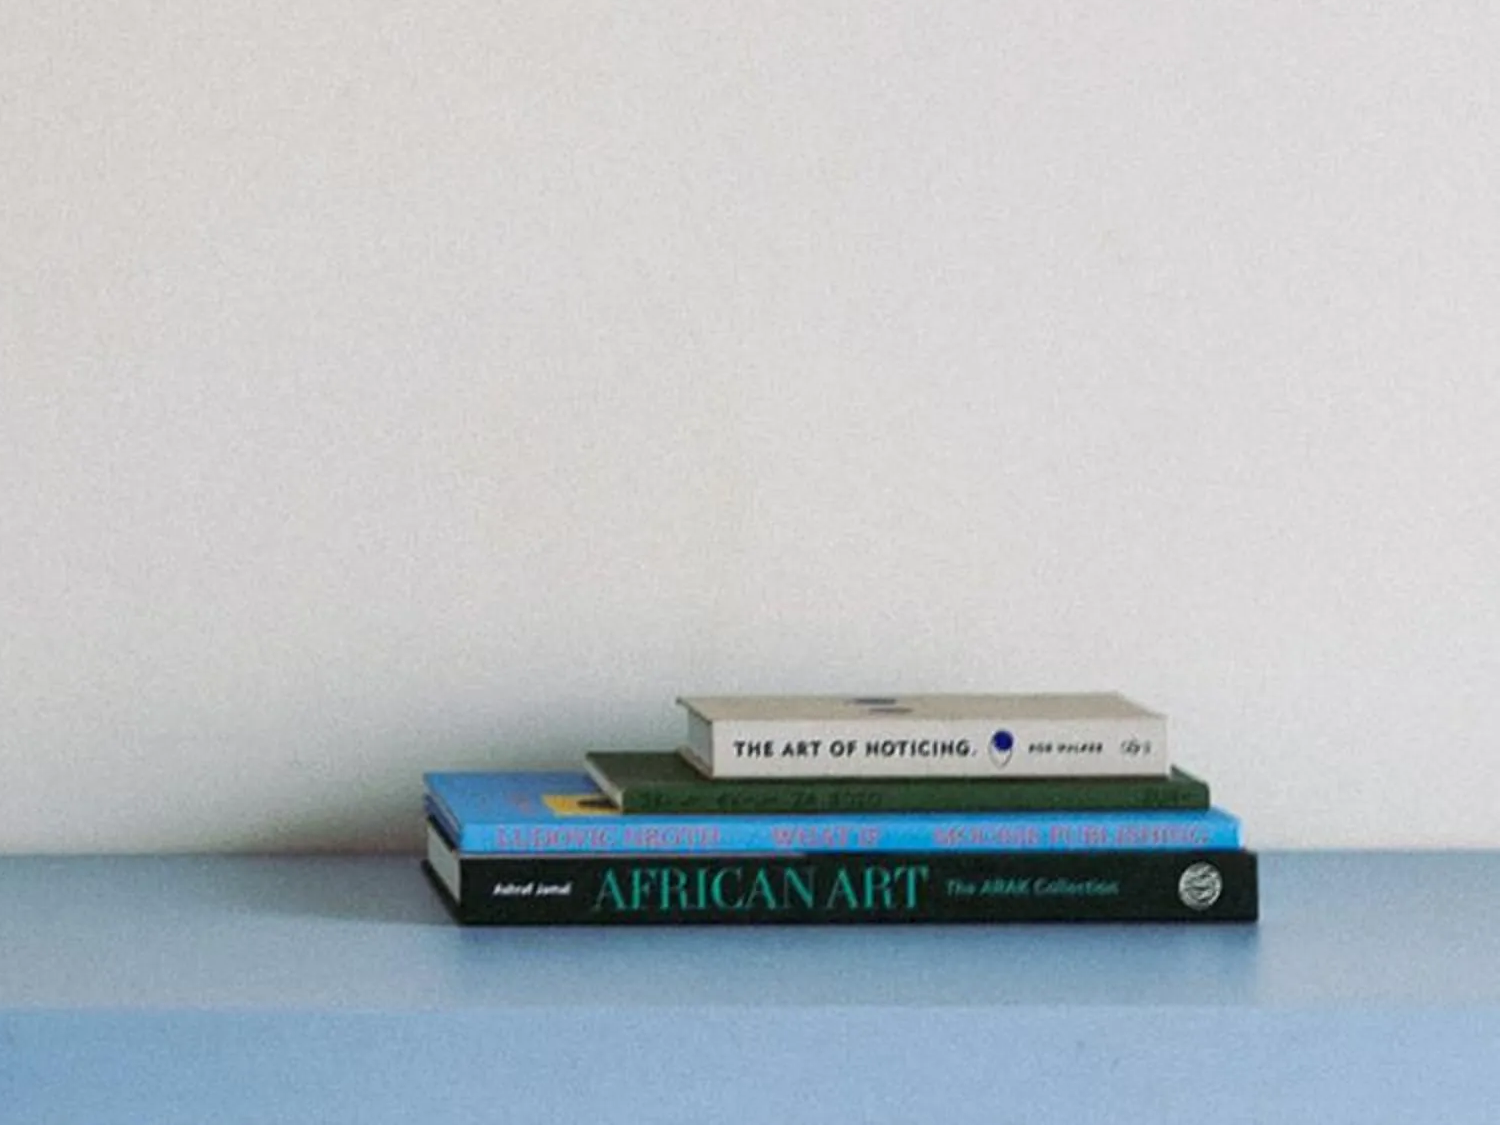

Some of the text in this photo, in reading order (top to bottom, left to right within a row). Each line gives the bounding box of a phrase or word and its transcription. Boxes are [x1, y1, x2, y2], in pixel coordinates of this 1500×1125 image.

[733, 739, 775, 758] THE
[781, 739, 822, 758] ART
[828, 739, 858, 758] OF
[772, 826, 848, 847] WHAT
[595, 865, 929, 911] AFRICAN ART
[947, 878, 976, 897] The
[1033, 877, 1120, 897] Collection
